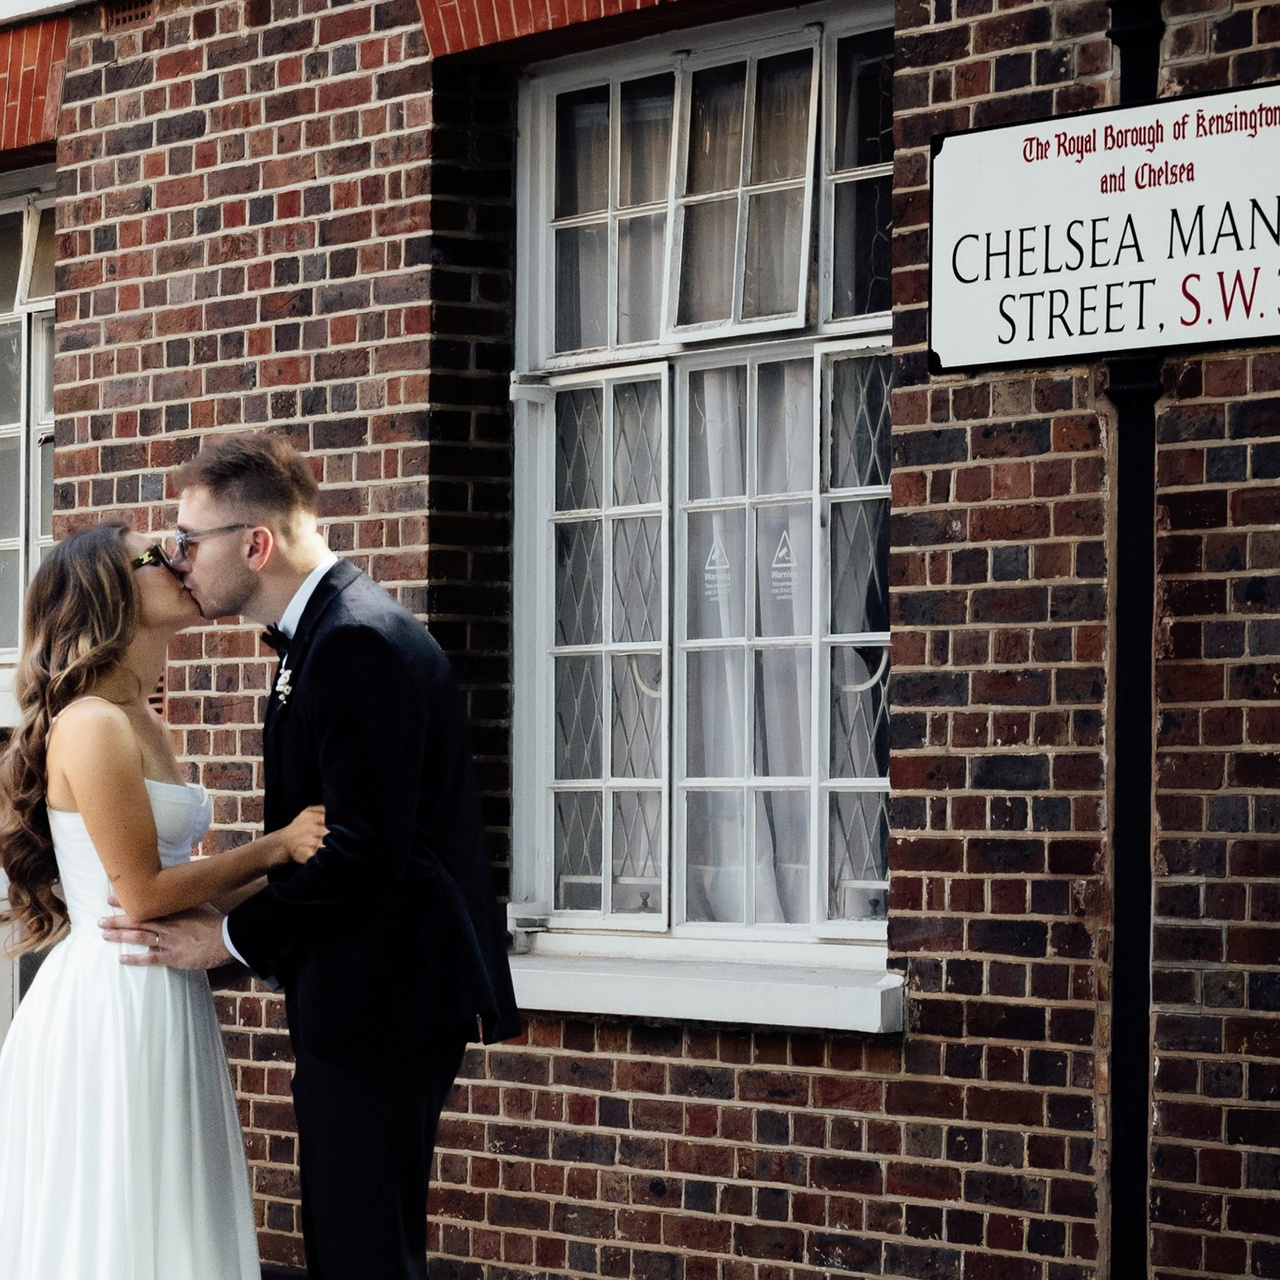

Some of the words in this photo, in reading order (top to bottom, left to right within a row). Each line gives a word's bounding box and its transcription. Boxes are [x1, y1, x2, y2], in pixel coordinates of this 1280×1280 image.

[1023, 136, 1050, 163] The
[1054, 128, 1097, 163] Royal
[1103, 119, 1164, 153] Borough
[1173, 113, 1190, 140] of
[1195, 102, 1280, 139] Kensington
[1101, 166, 1126, 195] and
[1134, 161, 1195, 190] Chelsea
[951, 213, 1145, 284] CHELSEA
[1166, 194, 1280, 260] MAN
[997, 277, 1165, 345] STREET,
[1179, 266, 1265, 327] S.W.
[771, 570, 799, 580] Warning
